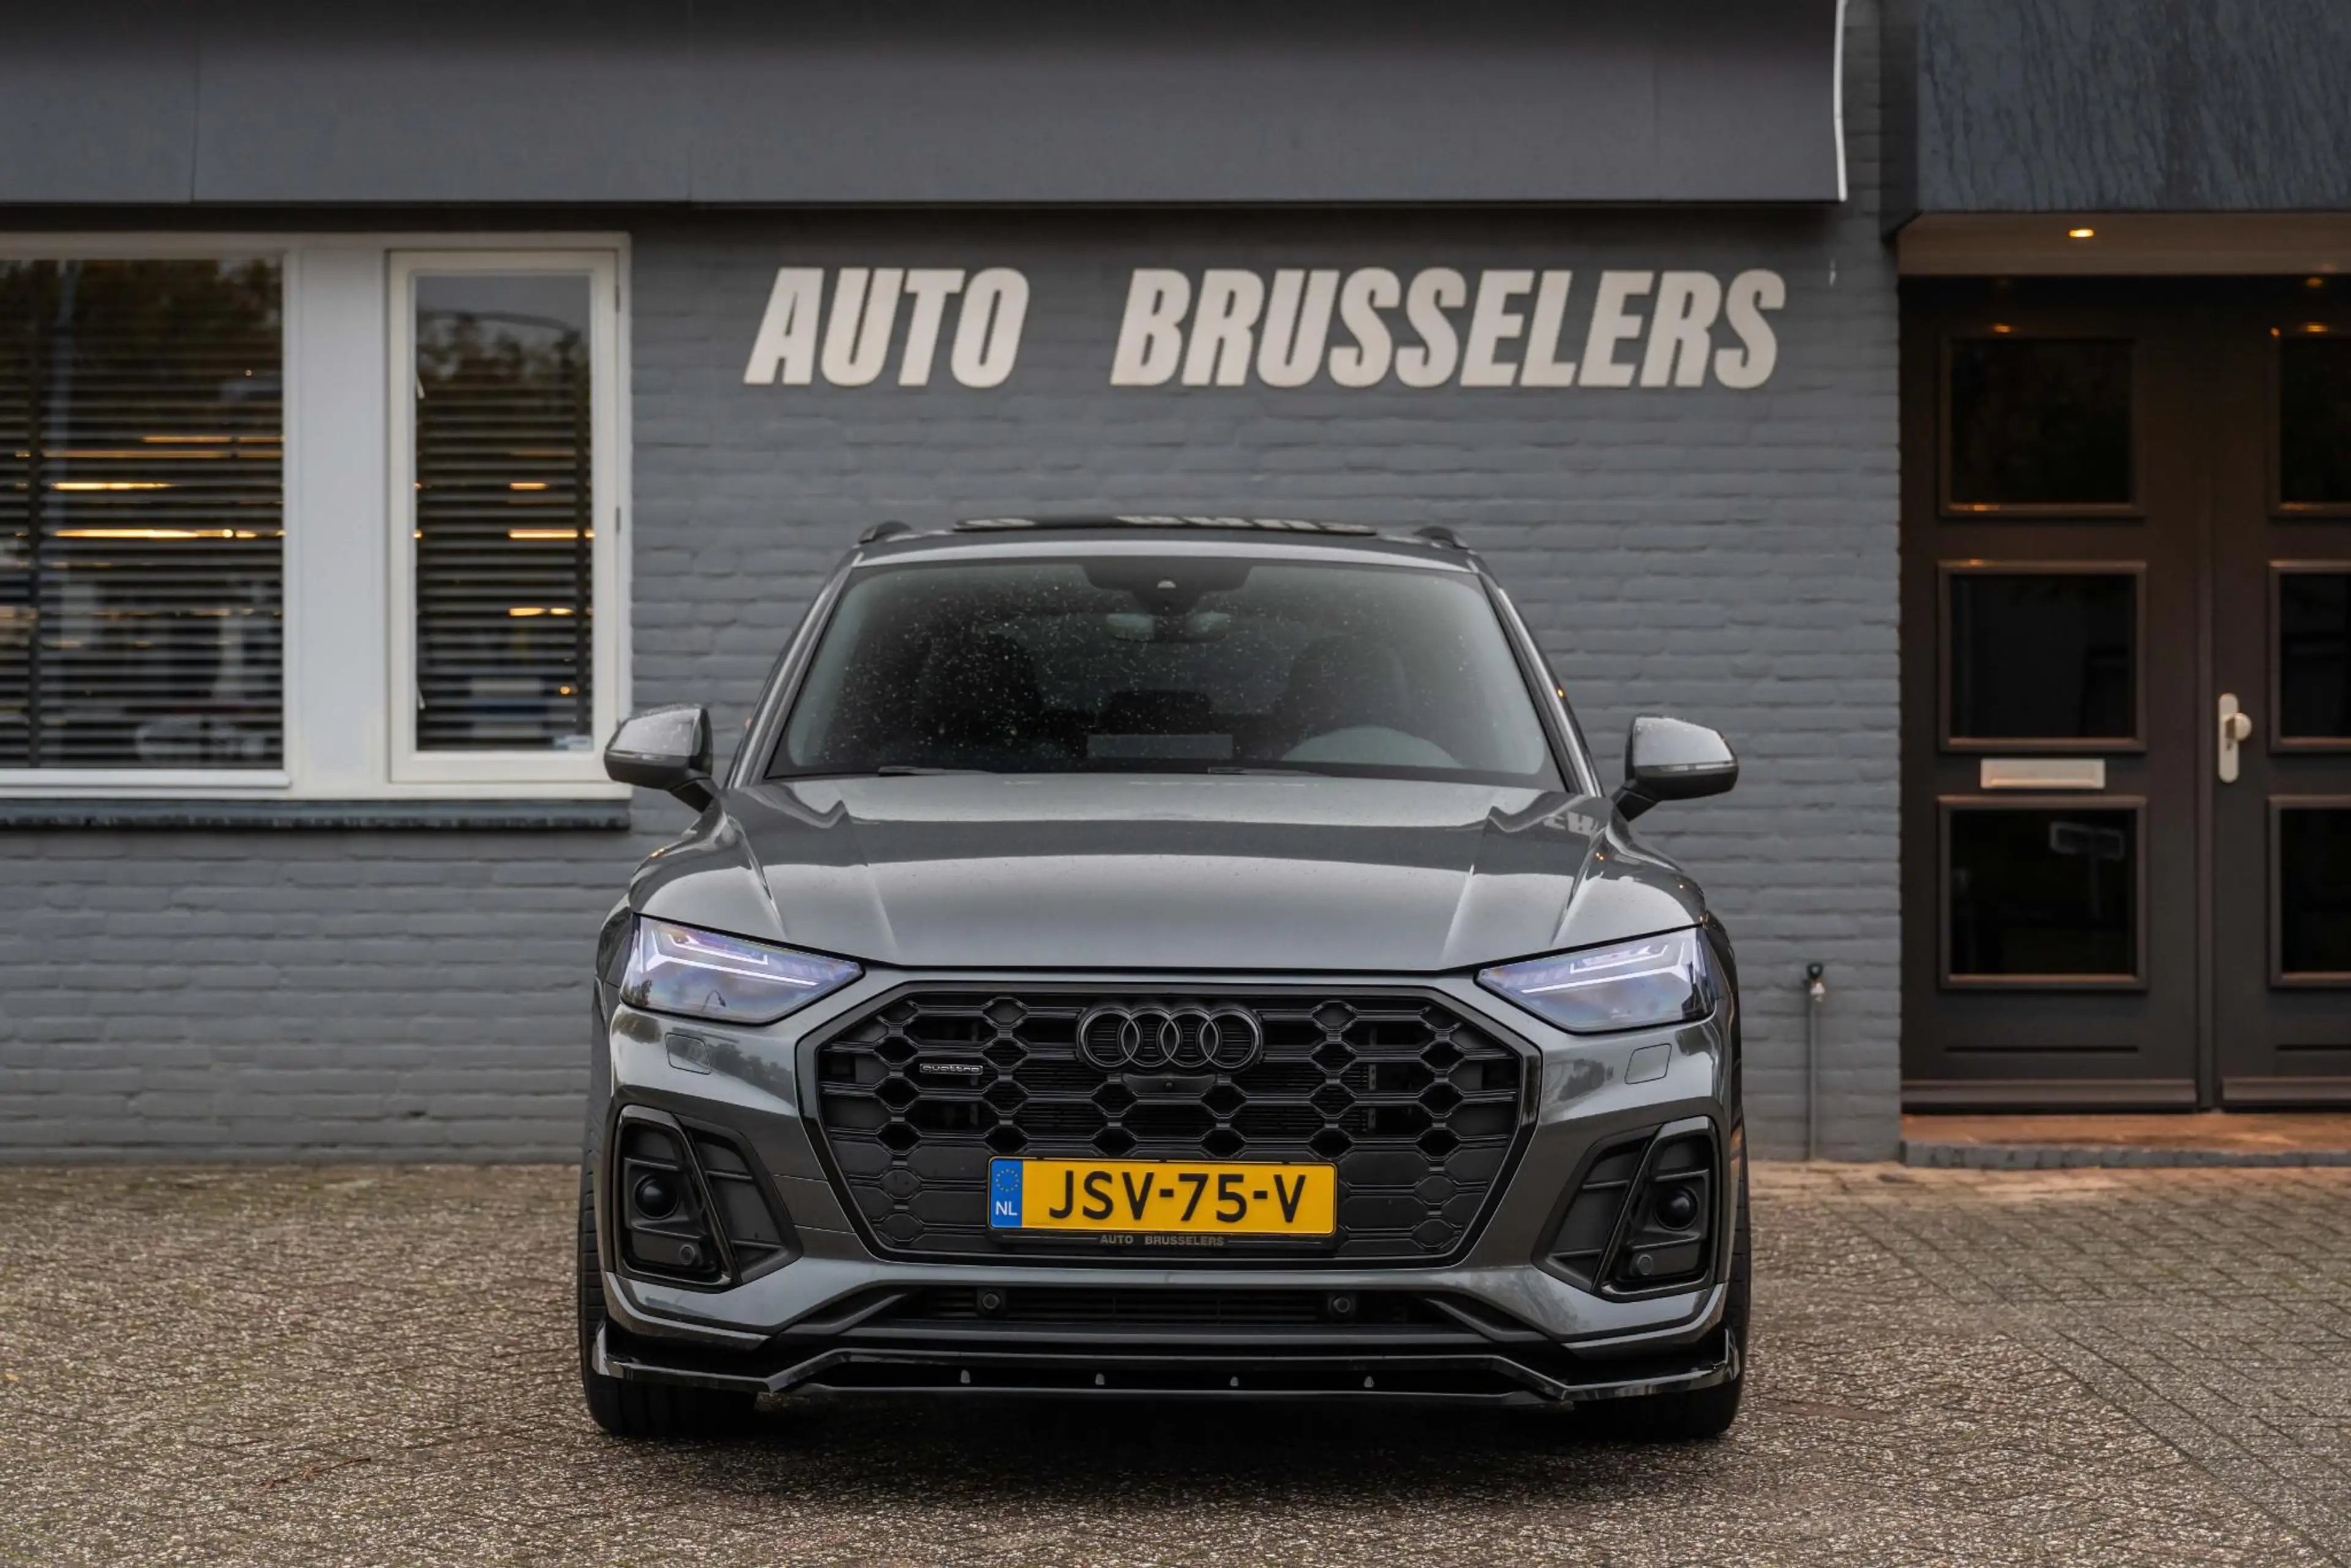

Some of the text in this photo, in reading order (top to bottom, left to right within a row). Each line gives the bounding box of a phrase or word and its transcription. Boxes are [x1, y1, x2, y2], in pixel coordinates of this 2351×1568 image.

[744, 269, 1787, 388] AUTO BRUSSELERS
[921, 1065, 980, 1074] quattro
[1049, 1170, 1307, 1223] JSV-75-V
[996, 1201, 1018, 1216] NL
[1100, 1234, 1224, 1247] AUTO BRUSSELERS
